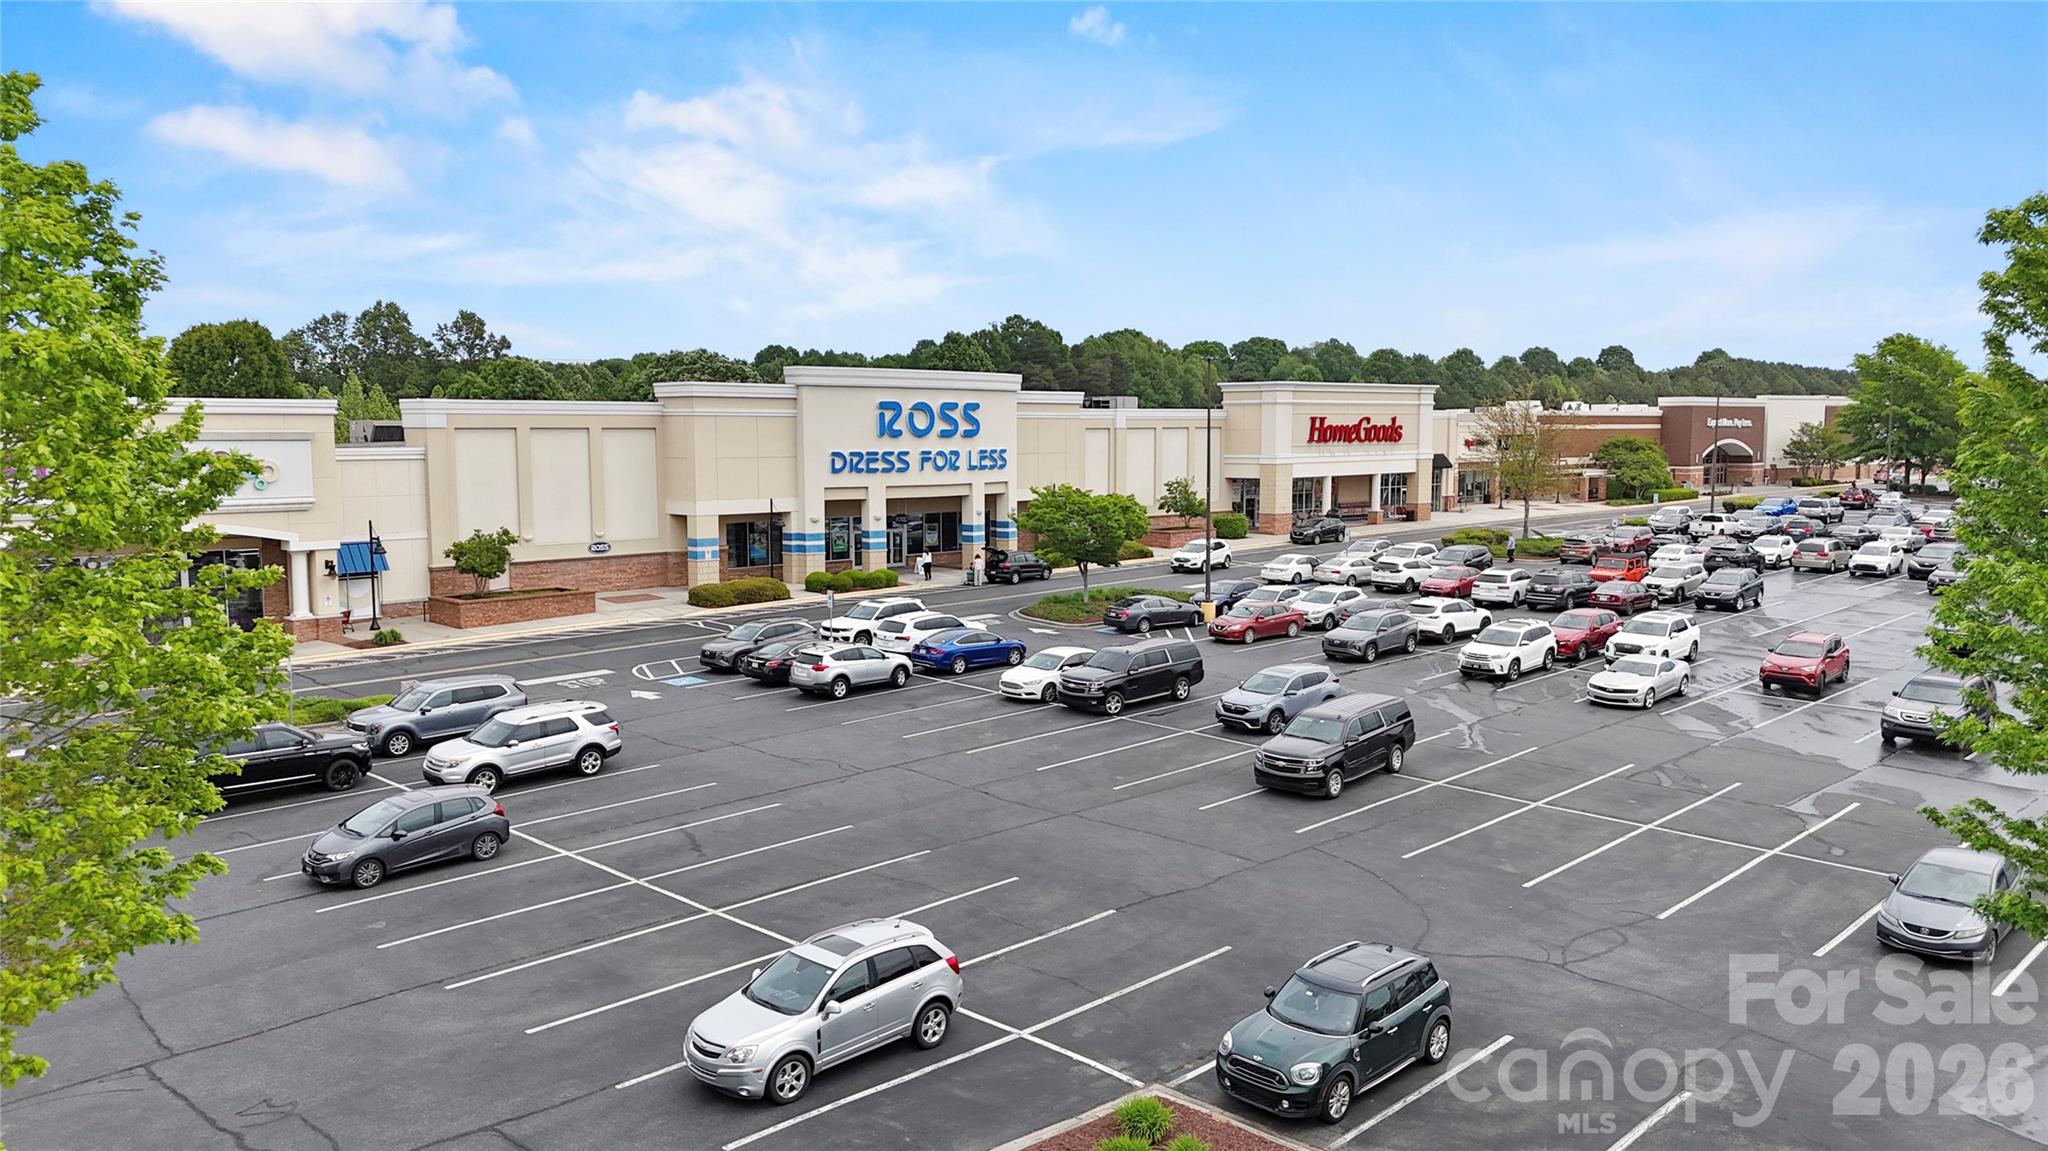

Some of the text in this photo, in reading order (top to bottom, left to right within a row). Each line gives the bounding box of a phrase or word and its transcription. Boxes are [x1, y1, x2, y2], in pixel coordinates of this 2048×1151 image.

[877, 400, 981, 438] ROSS
[1307, 416, 1403, 443] HomeGoods
[830, 449, 1008, 474] DRESS FOR LESS
